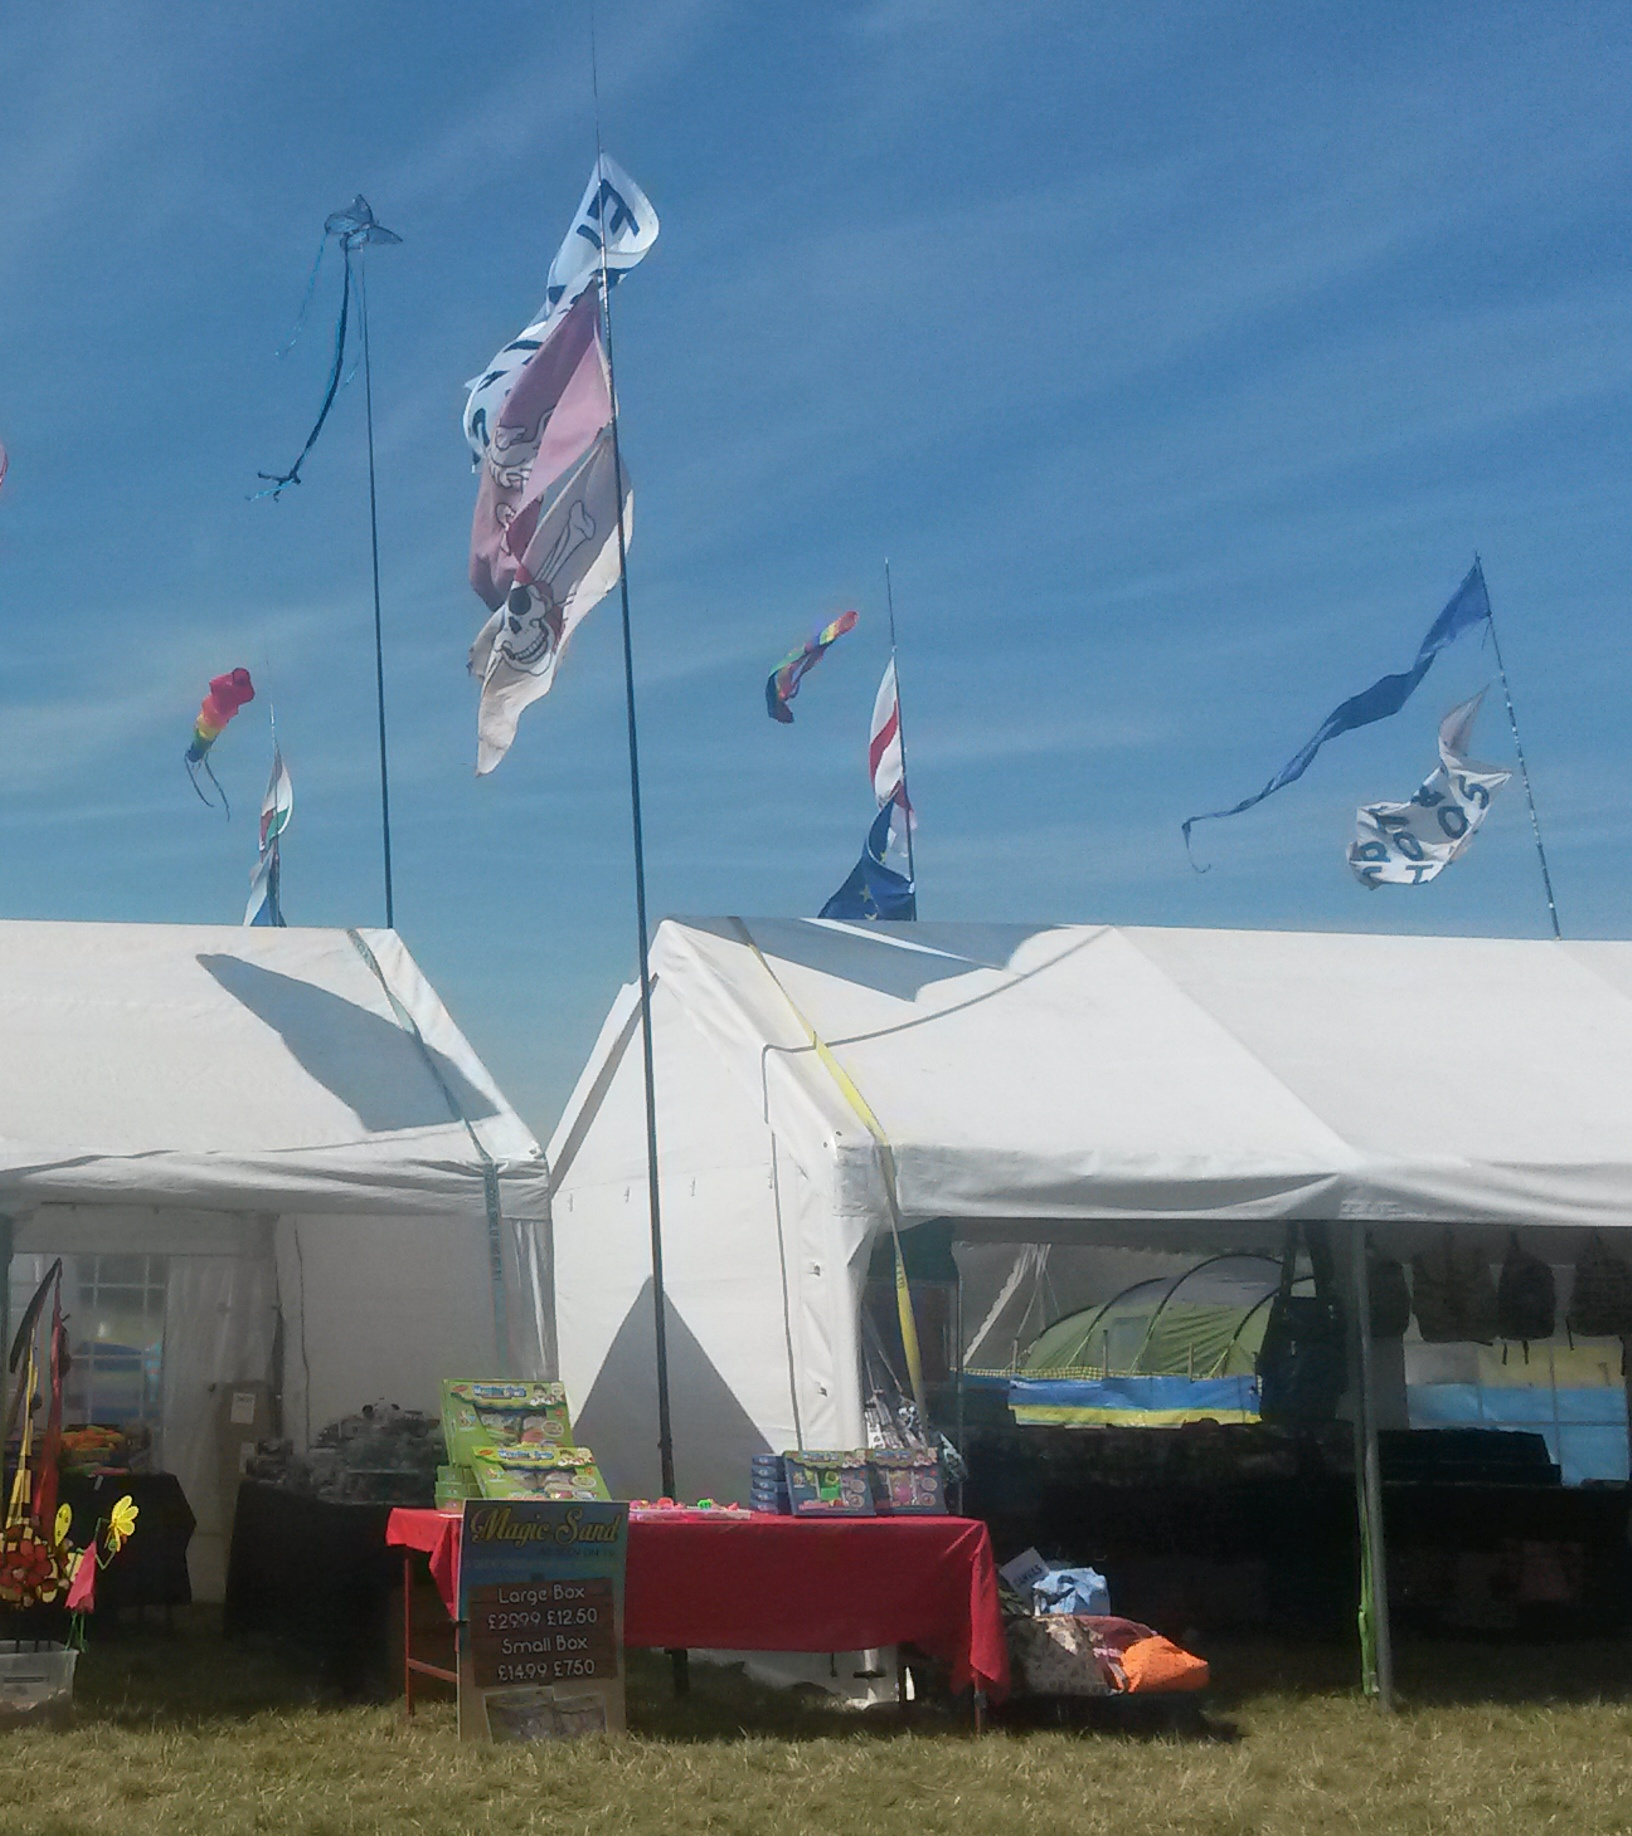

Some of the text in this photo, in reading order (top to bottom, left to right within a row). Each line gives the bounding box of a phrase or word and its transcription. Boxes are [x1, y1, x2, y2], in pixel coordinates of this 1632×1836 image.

[470, 1506, 622, 1547] Magic Sand
[498, 1584, 586, 1606] Large Box
[547, 1607, 598, 1626] £12.50
[501, 1635, 588, 1654] Small Box
[498, 1662, 548, 1681] £14.99
